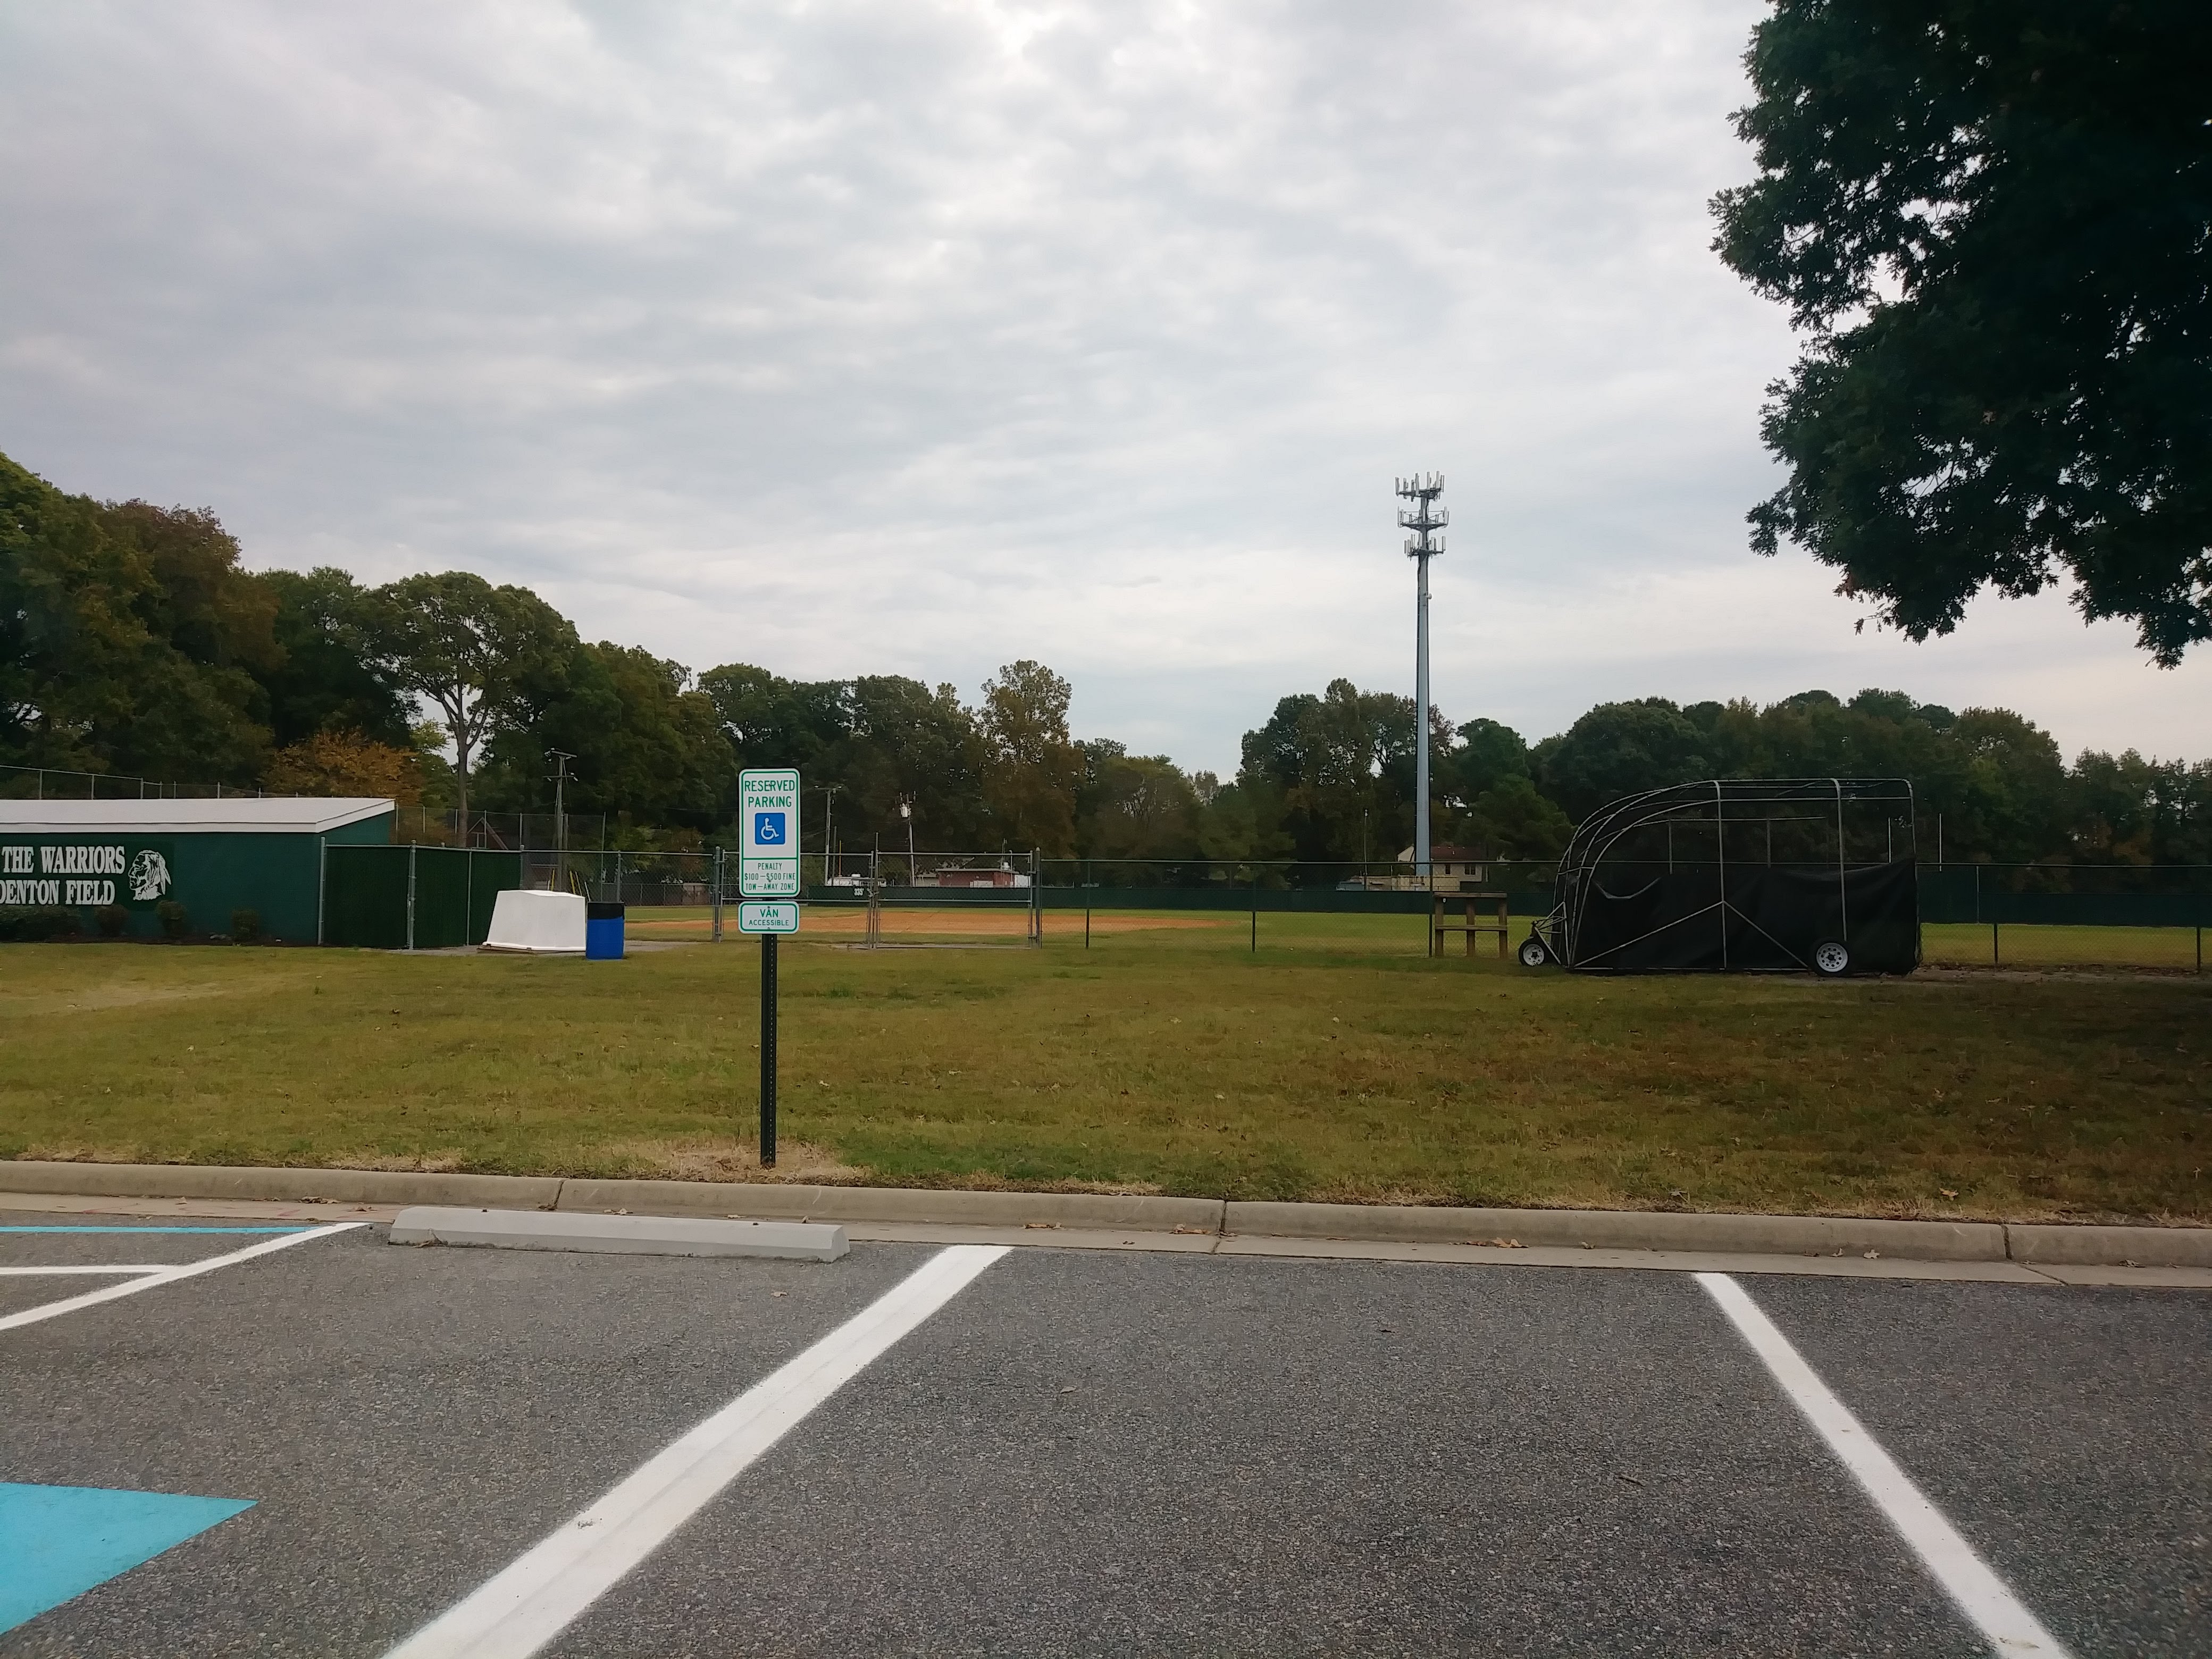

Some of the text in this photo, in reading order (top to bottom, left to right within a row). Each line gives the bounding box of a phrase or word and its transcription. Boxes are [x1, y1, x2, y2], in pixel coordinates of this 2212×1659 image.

[744, 780, 795, 792] RESERVED
[748, 796, 792, 808] PARKING
[2, 845, 125, 874] THE WARRIORS
[65, 879, 115, 905] FIELD
[760, 909, 778, 918] VAN
